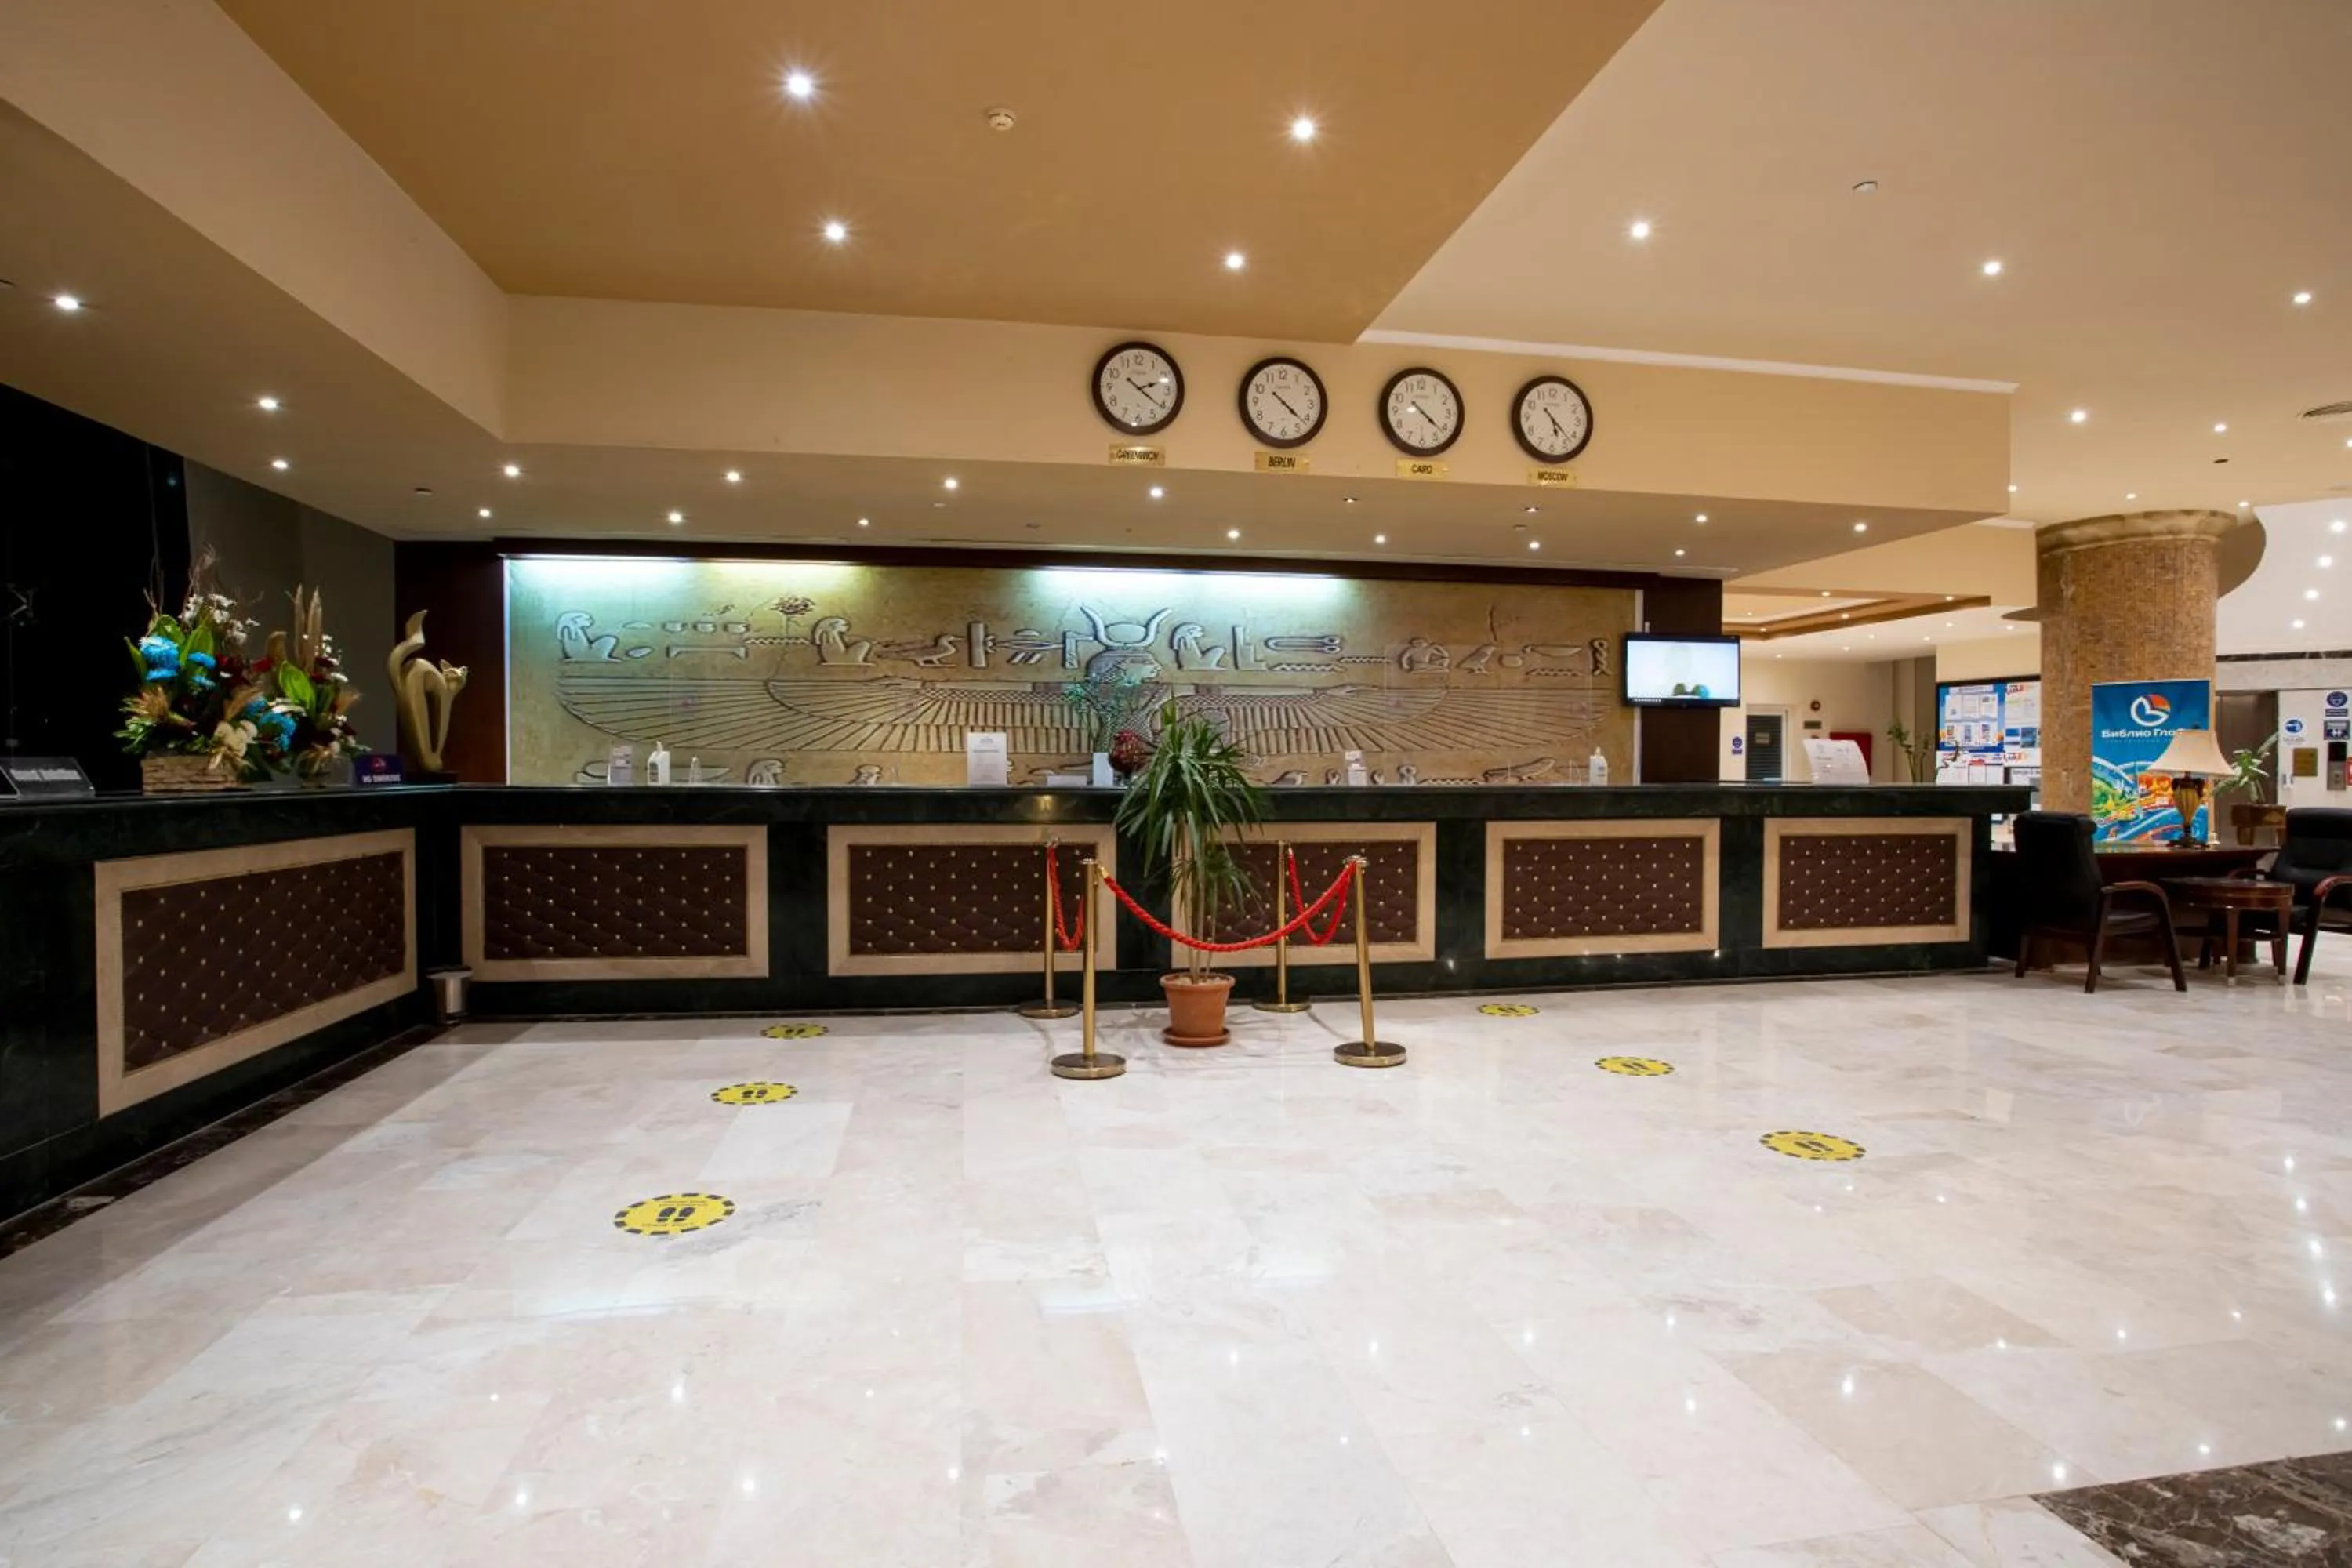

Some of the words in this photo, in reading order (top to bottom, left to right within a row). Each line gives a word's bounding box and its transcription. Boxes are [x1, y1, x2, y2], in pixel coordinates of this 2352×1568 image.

[1268, 456, 1296, 468] BERLIN
[1537, 471, 1568, 481] MOSCOW
[2101, 728, 2152, 738] Библио
